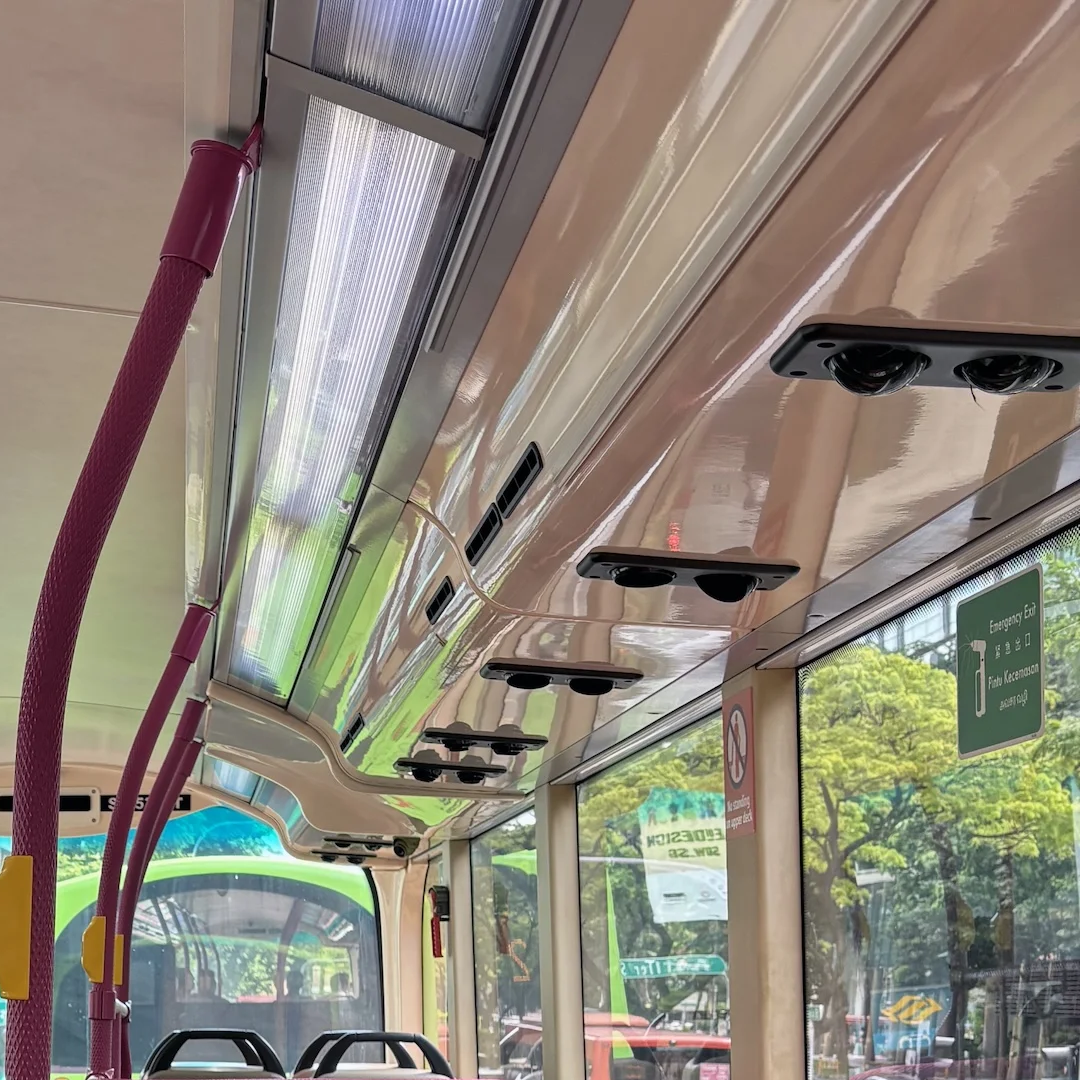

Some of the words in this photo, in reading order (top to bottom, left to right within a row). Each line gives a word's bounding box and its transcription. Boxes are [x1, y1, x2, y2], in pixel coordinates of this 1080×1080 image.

[990, 612, 1022, 634] Emergency
[1024, 602, 1036, 619] Exit
[988, 675, 1002, 690] Pintu
[1004, 663, 1039, 684] Kecemasan
